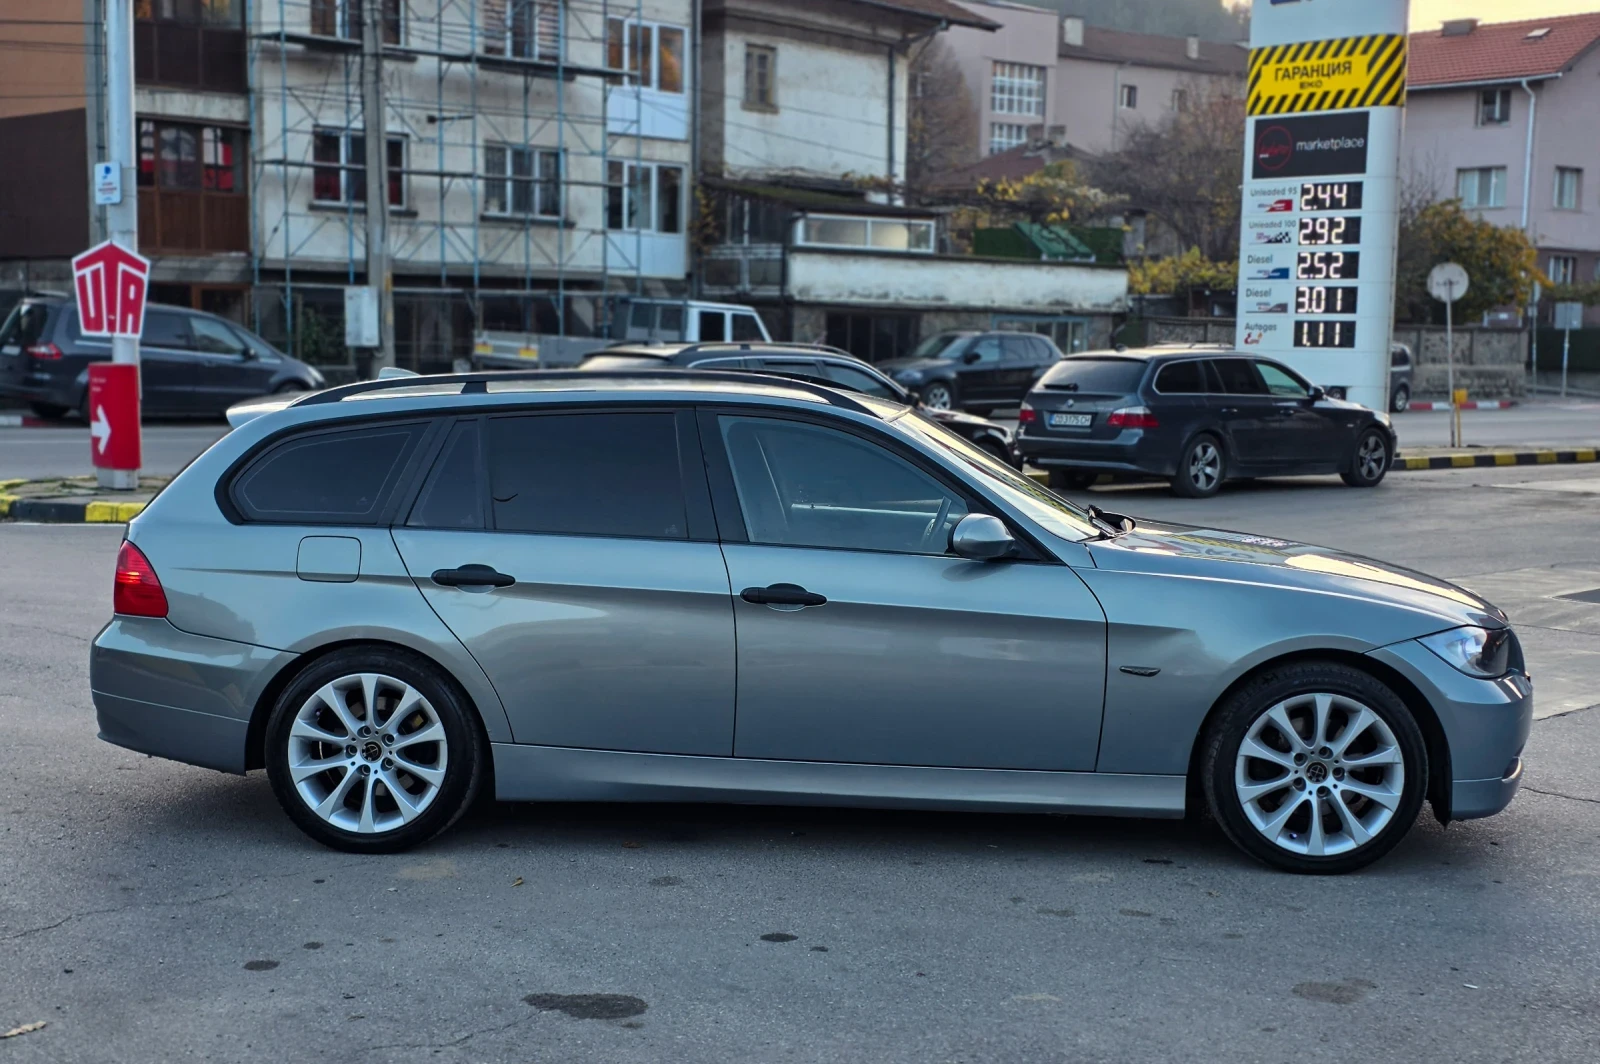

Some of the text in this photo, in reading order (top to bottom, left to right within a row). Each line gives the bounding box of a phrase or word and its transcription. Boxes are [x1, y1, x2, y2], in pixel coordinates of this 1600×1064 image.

[1274, 60, 1353, 82] ГАРАНЦИЯ
[1296, 136, 1365, 152] marketplace
[1250, 186, 1298, 197] Unleaded 95
[1301, 183, 1348, 210] 2.44
[1248, 219, 1297, 229] Unleaded 100
[1299, 217, 1346, 244] 2.92
[1247, 254, 1273, 264] Diesel
[1297, 252, 1344, 278] 2.52
[1245, 288, 1272, 298] Diesel
[1297, 286, 1342, 313] 3.01
[1244, 322, 1277, 333] Autogas
[1302, 322, 1341, 347] 1.11
